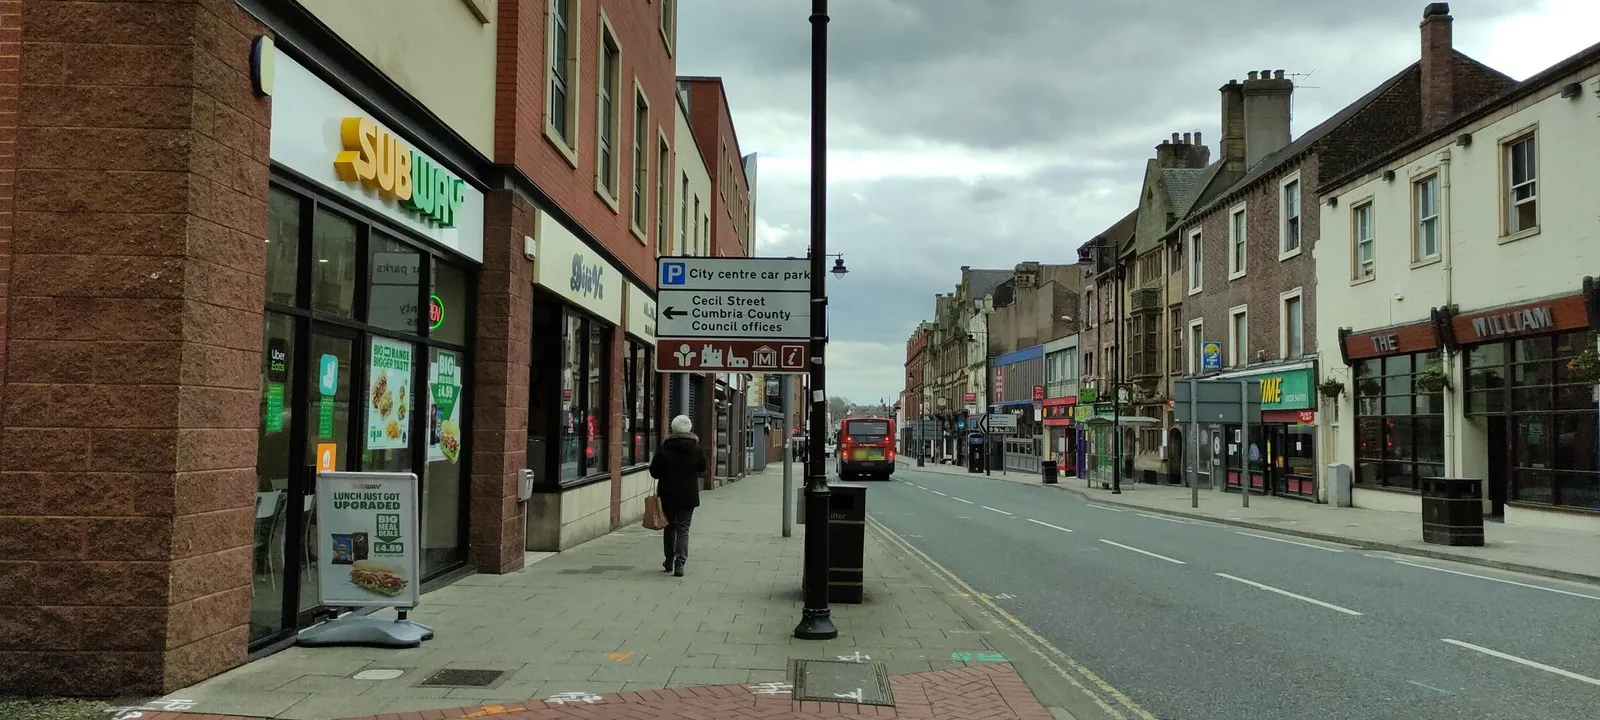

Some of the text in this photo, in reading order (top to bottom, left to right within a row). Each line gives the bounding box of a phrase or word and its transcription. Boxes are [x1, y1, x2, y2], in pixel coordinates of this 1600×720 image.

[335, 117, 465, 228] SUBWAY
[689, 268, 811, 282] City centre car park
[692, 295, 765, 306] Cecil Street
[692, 308, 791, 321] Cumbria County
[692, 321, 782, 332] Council offices
[1472, 306, 1553, 337] WILLIAM
[1371, 334, 1398, 353] THE
[271, 349, 286, 361] Uber
[374, 344, 383, 357] BIG
[392, 347, 410, 361] RANGE
[271, 362, 285, 372] Eats
[374, 356, 410, 372] BIGGER TASTE
[439, 354, 454, 376] BIG
[1260, 377, 1282, 403] TIME
[334, 492, 400, 501] LUNCH JUST GOT
[334, 501, 401, 510] UPGRADED
[378, 515, 398, 523] BIG
[378, 523, 398, 531] MEAL
